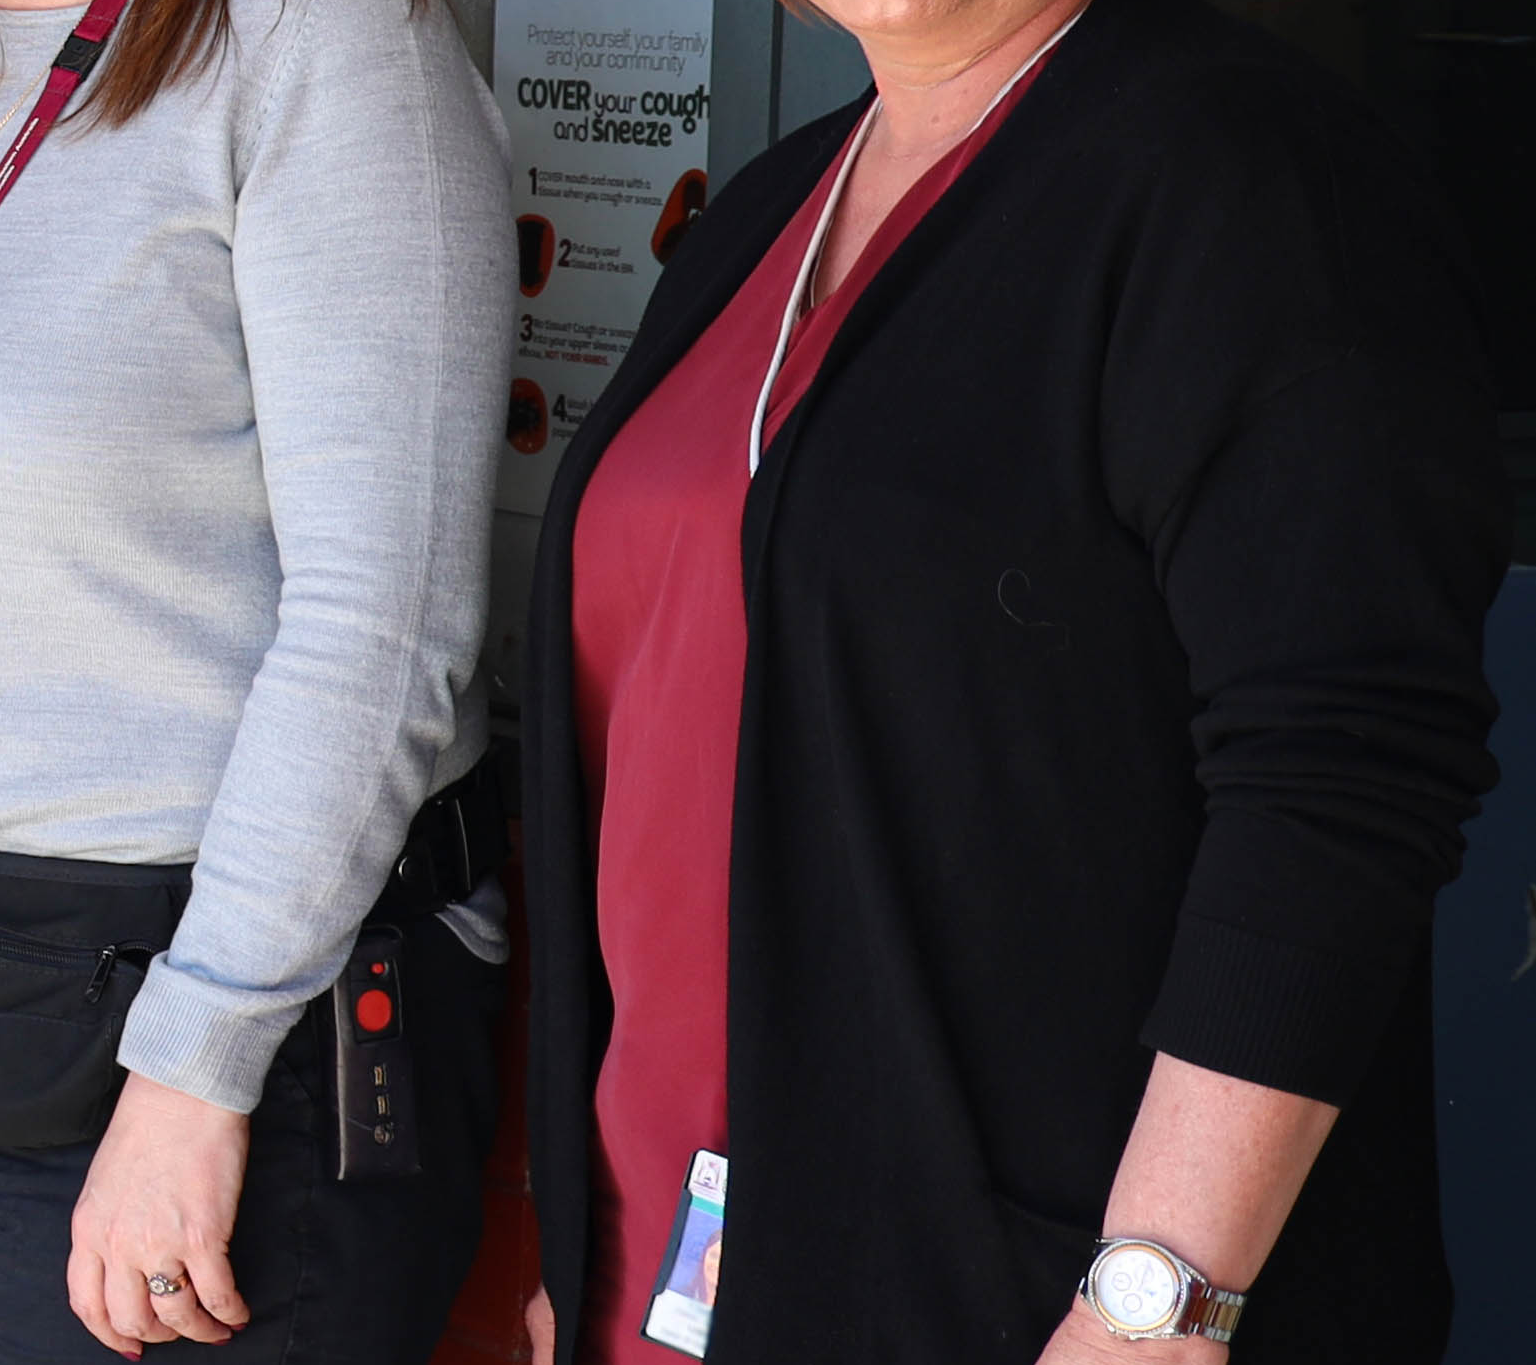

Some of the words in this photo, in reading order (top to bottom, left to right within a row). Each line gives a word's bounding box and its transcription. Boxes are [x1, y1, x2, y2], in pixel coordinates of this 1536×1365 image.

[527, 24, 575, 46] Protect
[635, 33, 664, 54] your
[668, 30, 708, 58] family
[546, 48, 572, 66] and
[575, 52, 604, 72] your
[607, 52, 686, 77] community
[518, 77, 591, 111] COVER
[595, 92, 637, 118] your
[641, 84, 710, 134] cough
[554, 117, 588, 142] and
[592, 118, 672, 147] sneeze
[528, 167, 537, 195] 1
[558, 239, 572, 267] 2
[520, 314, 533, 342] 3
[553, 394, 567, 422] 4
